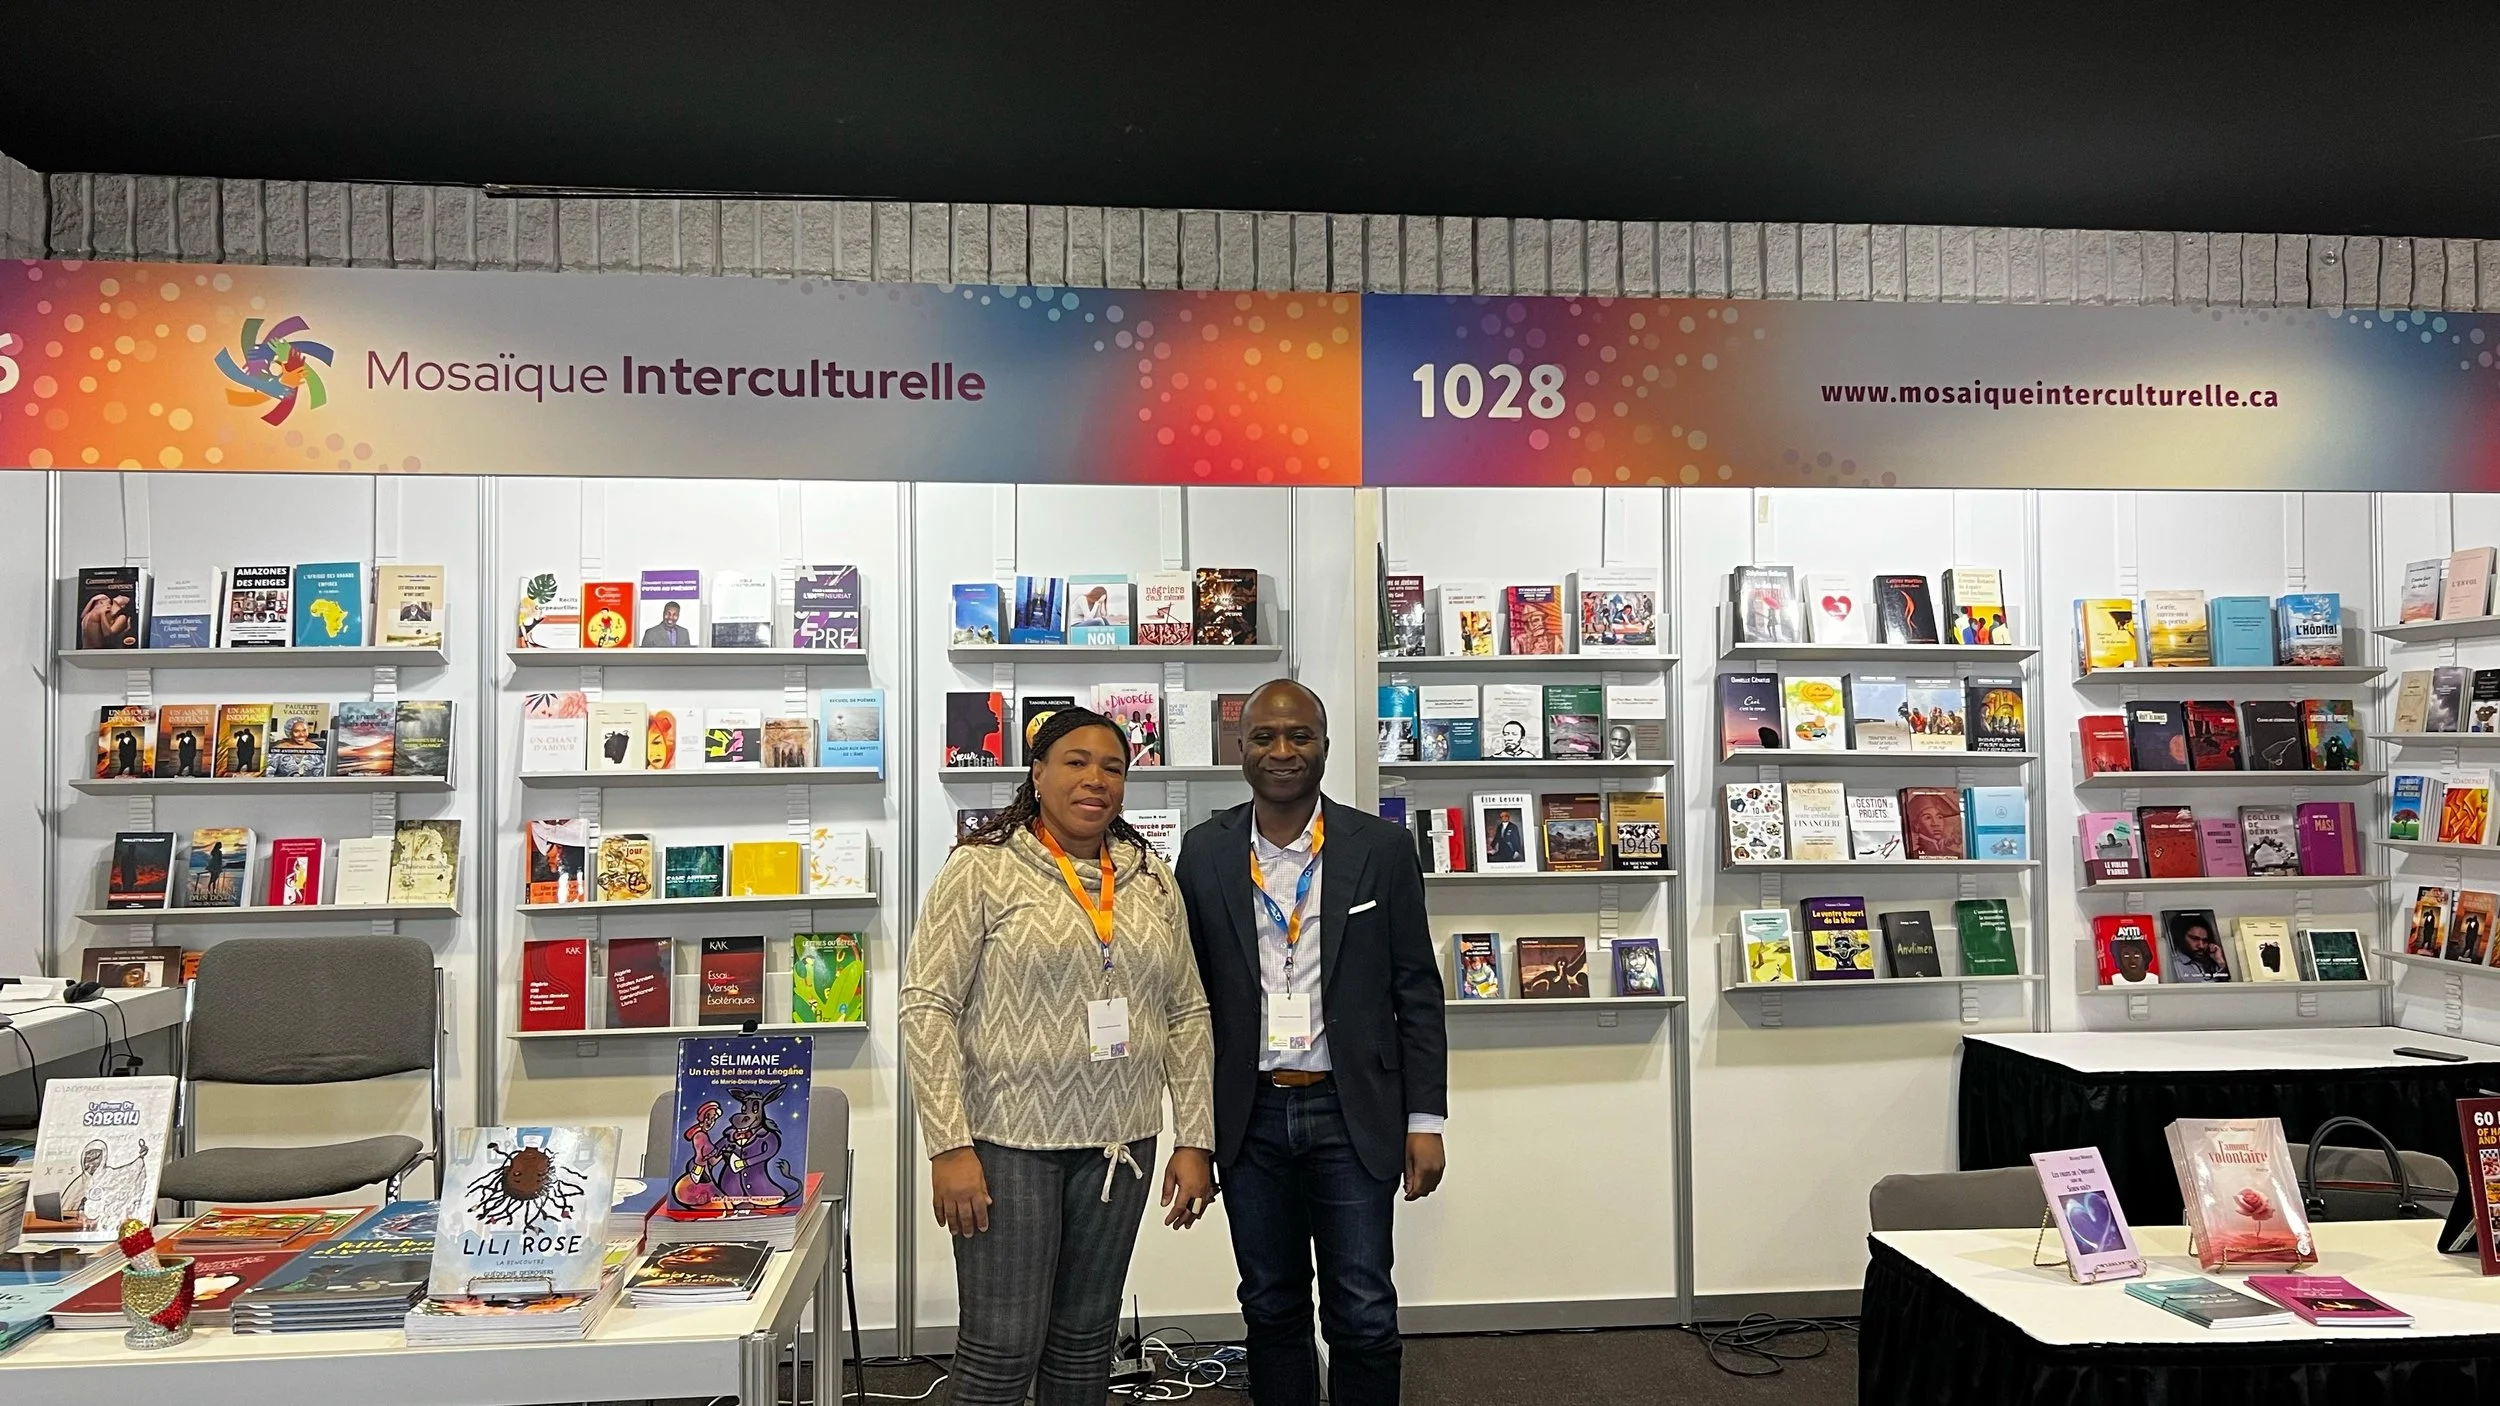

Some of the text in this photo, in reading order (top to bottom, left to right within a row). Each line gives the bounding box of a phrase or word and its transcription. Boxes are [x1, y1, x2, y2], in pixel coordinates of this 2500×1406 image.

[368, 351, 986, 402] Mosaïque Interculturelle
[1412, 363, 1566, 418] 1028
[1821, 380, 2279, 410] www.mosaiqueinterculturelle.ca
[236, 568, 287, 576] AMAZONES
[236, 579, 286, 587] DES NEIGES
[1145, 585, 1185, 595] négriers
[2296, 623, 2337, 635] L'Hôpital
[1087, 632, 1116, 645] NON
[1855, 798, 1888, 808] GESTION
[1793, 819, 1841, 828] FINANCIÈRE
[1620, 838, 1660, 854] 1946
[709, 941, 729, 950] KAK
[708, 984, 740, 992] Versets
[710, 1053, 780, 1066] SÉLIMANE
[689, 1067, 804, 1077] Un très bel âne de Léogâne
[2474, 1111, 2494, 1126] 60
[2477, 1128, 2489, 1136] OF
[2479, 1136, 2497, 1145] AND
[463, 1235, 582, 1256] LILI ROSE
